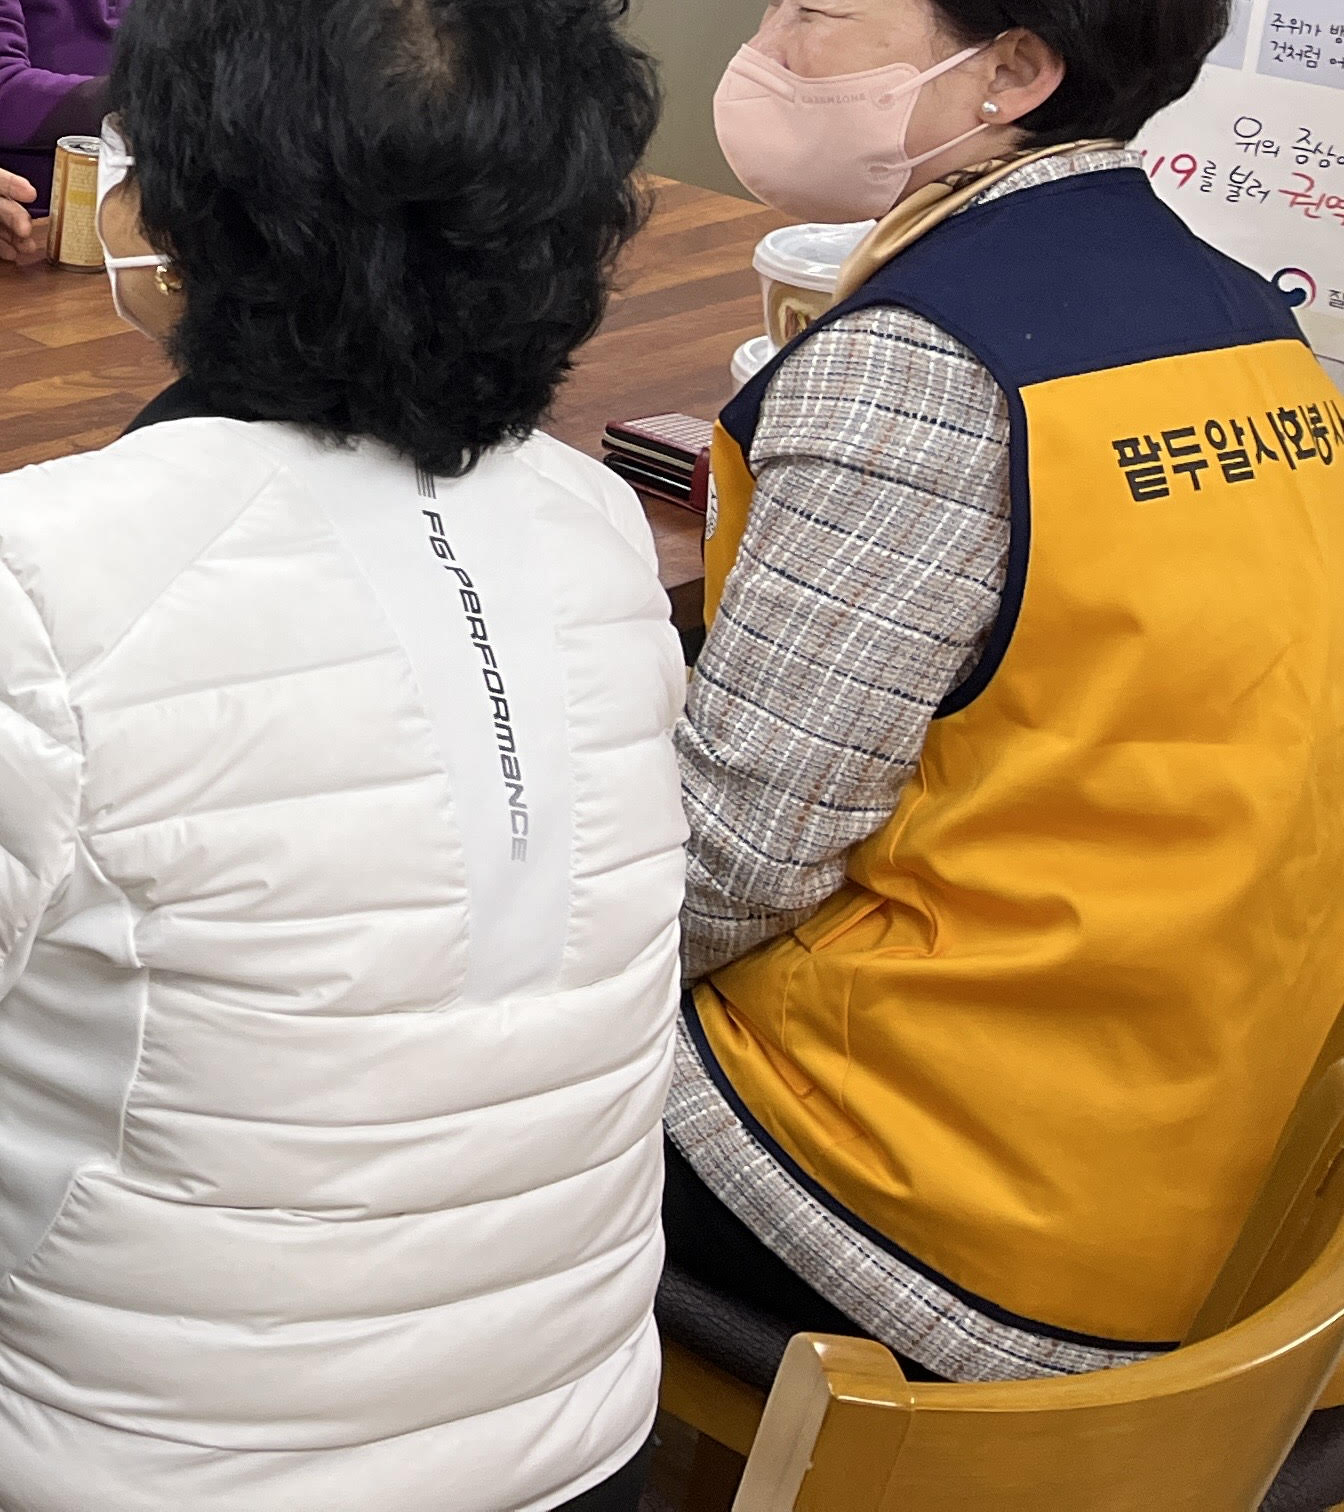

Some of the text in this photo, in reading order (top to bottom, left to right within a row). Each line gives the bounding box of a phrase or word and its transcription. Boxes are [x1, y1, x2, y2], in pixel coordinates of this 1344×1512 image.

[1270, 12, 1322, 37] 주위가
[1270, 40, 1320, 68] 것처럼
[1234, 116, 1280, 157] 위의
[1141, 149, 1217, 193] 19를
[1224, 165, 1271, 203] 불러
[443, 564, 529, 863] PERFORMANCE
